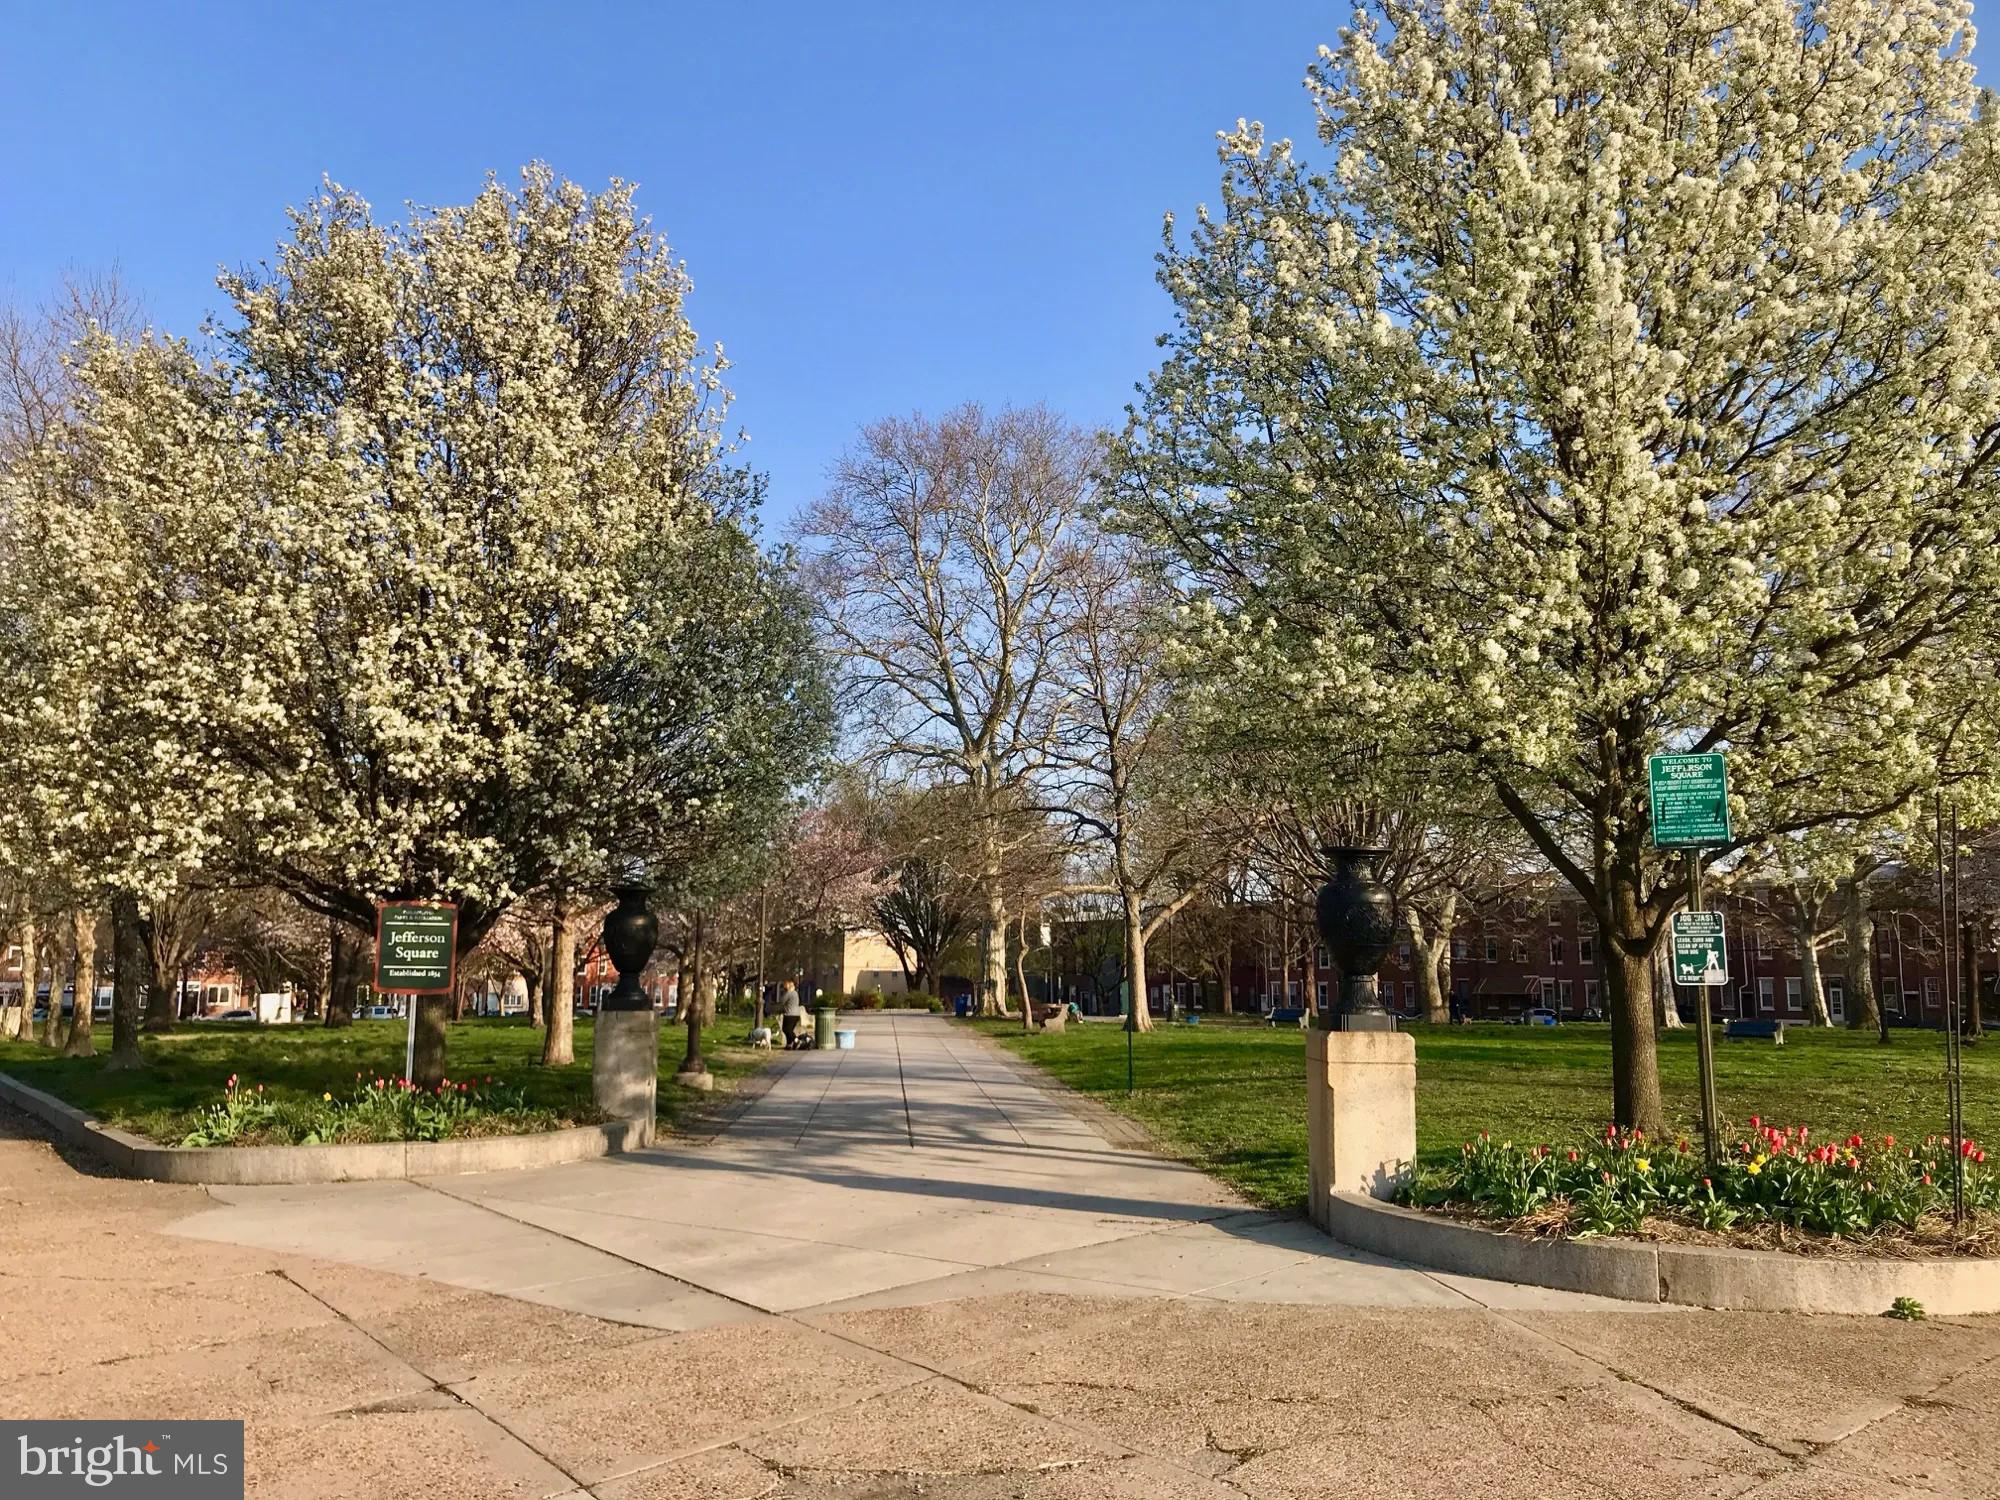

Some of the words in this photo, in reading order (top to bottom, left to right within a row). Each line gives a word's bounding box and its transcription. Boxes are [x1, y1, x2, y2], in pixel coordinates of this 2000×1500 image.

[1661, 763, 1712, 774] JEFFERSON
[1670, 771, 1703, 779] SQUARE
[387, 931, 446, 946] Jefferson
[395, 946, 439, 961] Square
[389, 969, 426, 977] Established
